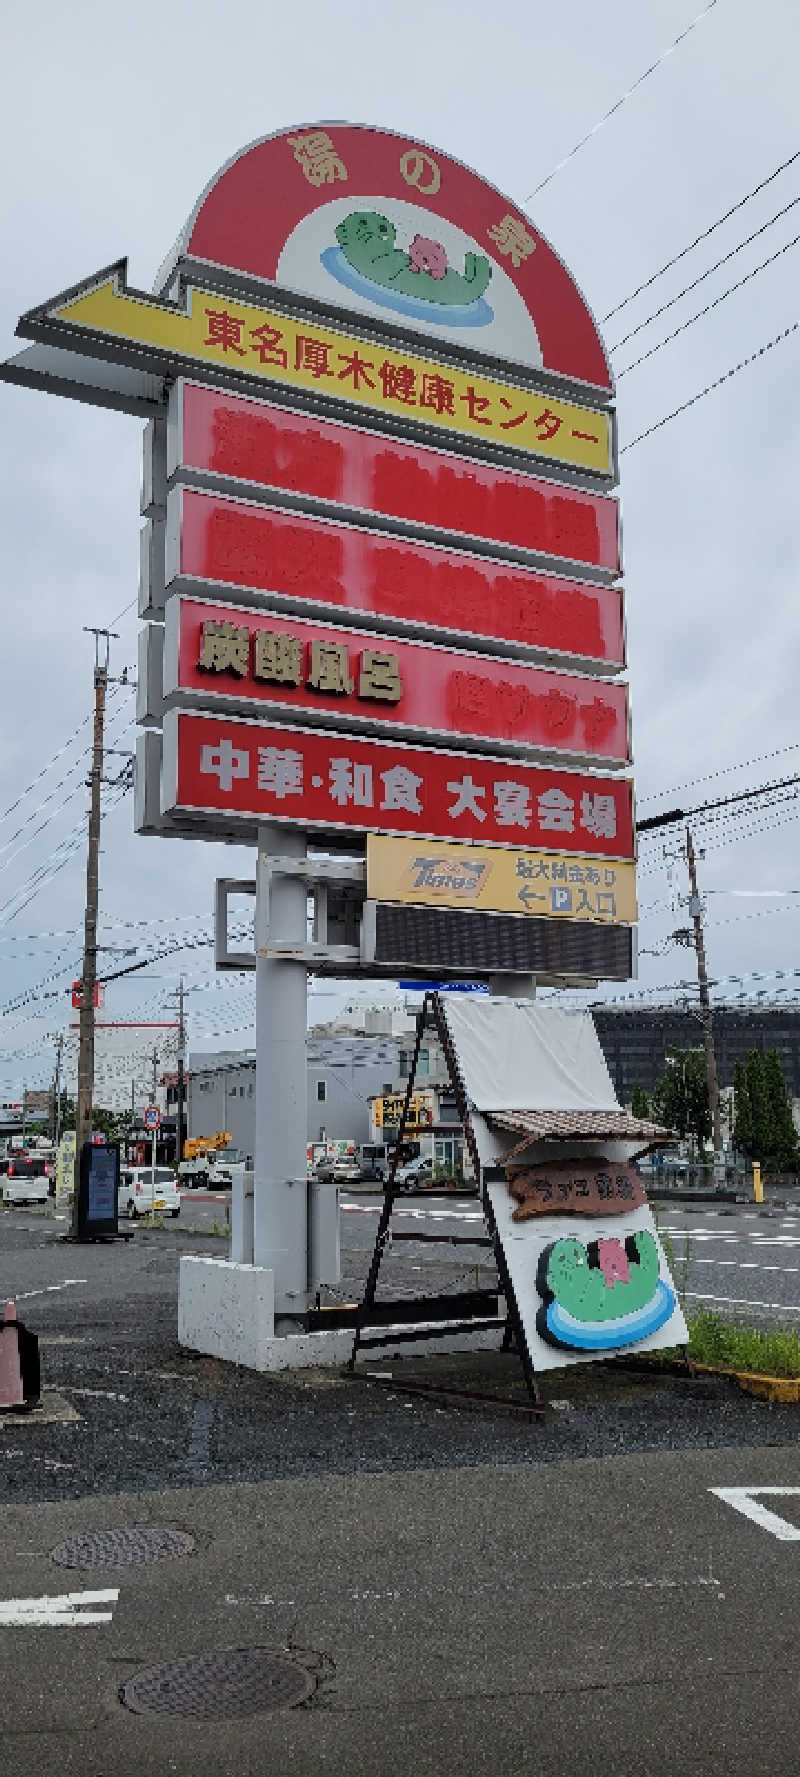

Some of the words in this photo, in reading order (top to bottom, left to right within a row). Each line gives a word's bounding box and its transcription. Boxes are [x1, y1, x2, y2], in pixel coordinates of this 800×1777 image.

[287, 131, 536, 267] 湯の泉
[204, 308, 599, 443] 東名厚木健康センター
[197, 619, 403, 702] 炭酸風呂
[200, 739, 424, 815] 中華・和食
[446, 775, 618, 839] 大宴会場
[411, 857, 486, 889] Times
[515, 857, 617, 888] 最大料金あり
[575, 888, 617, 917] 入口
